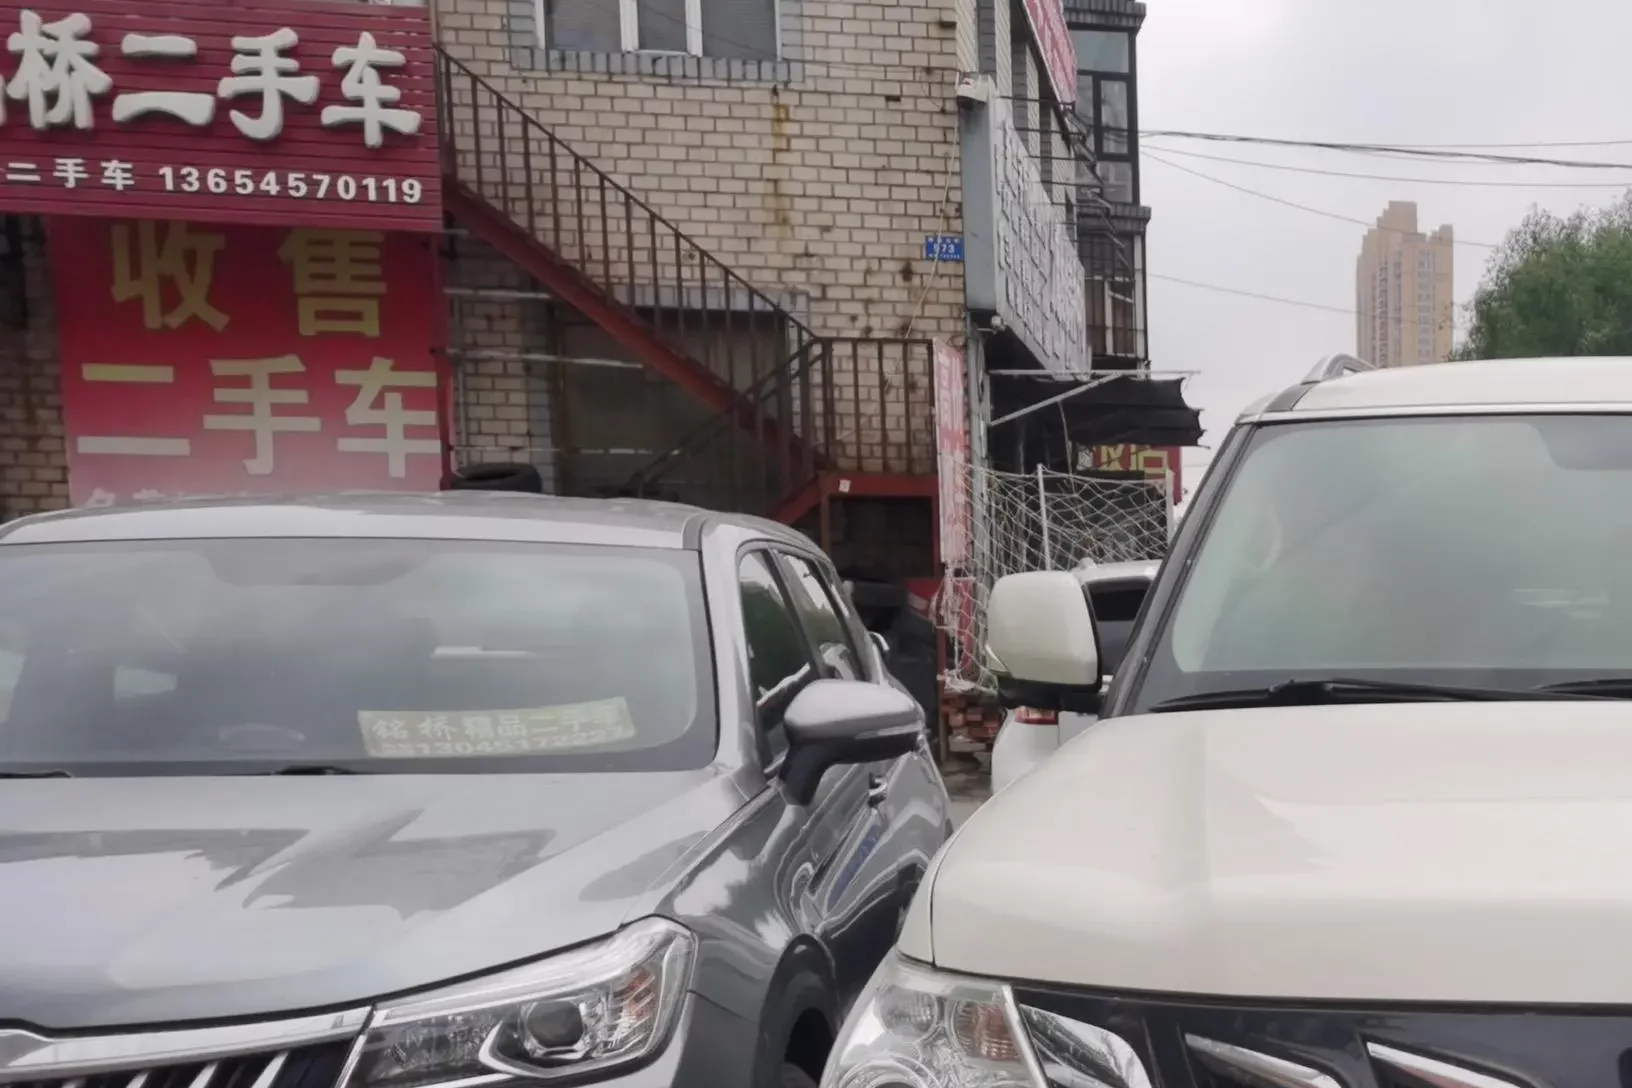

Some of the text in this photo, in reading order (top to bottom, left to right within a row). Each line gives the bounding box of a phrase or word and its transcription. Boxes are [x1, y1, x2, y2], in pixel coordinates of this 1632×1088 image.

[0, 9, 422, 149] 桥二手车
[158, 166, 422, 204] 13654570119
[110, 220, 387, 337] 收售
[77, 354, 441, 478] 二手车
